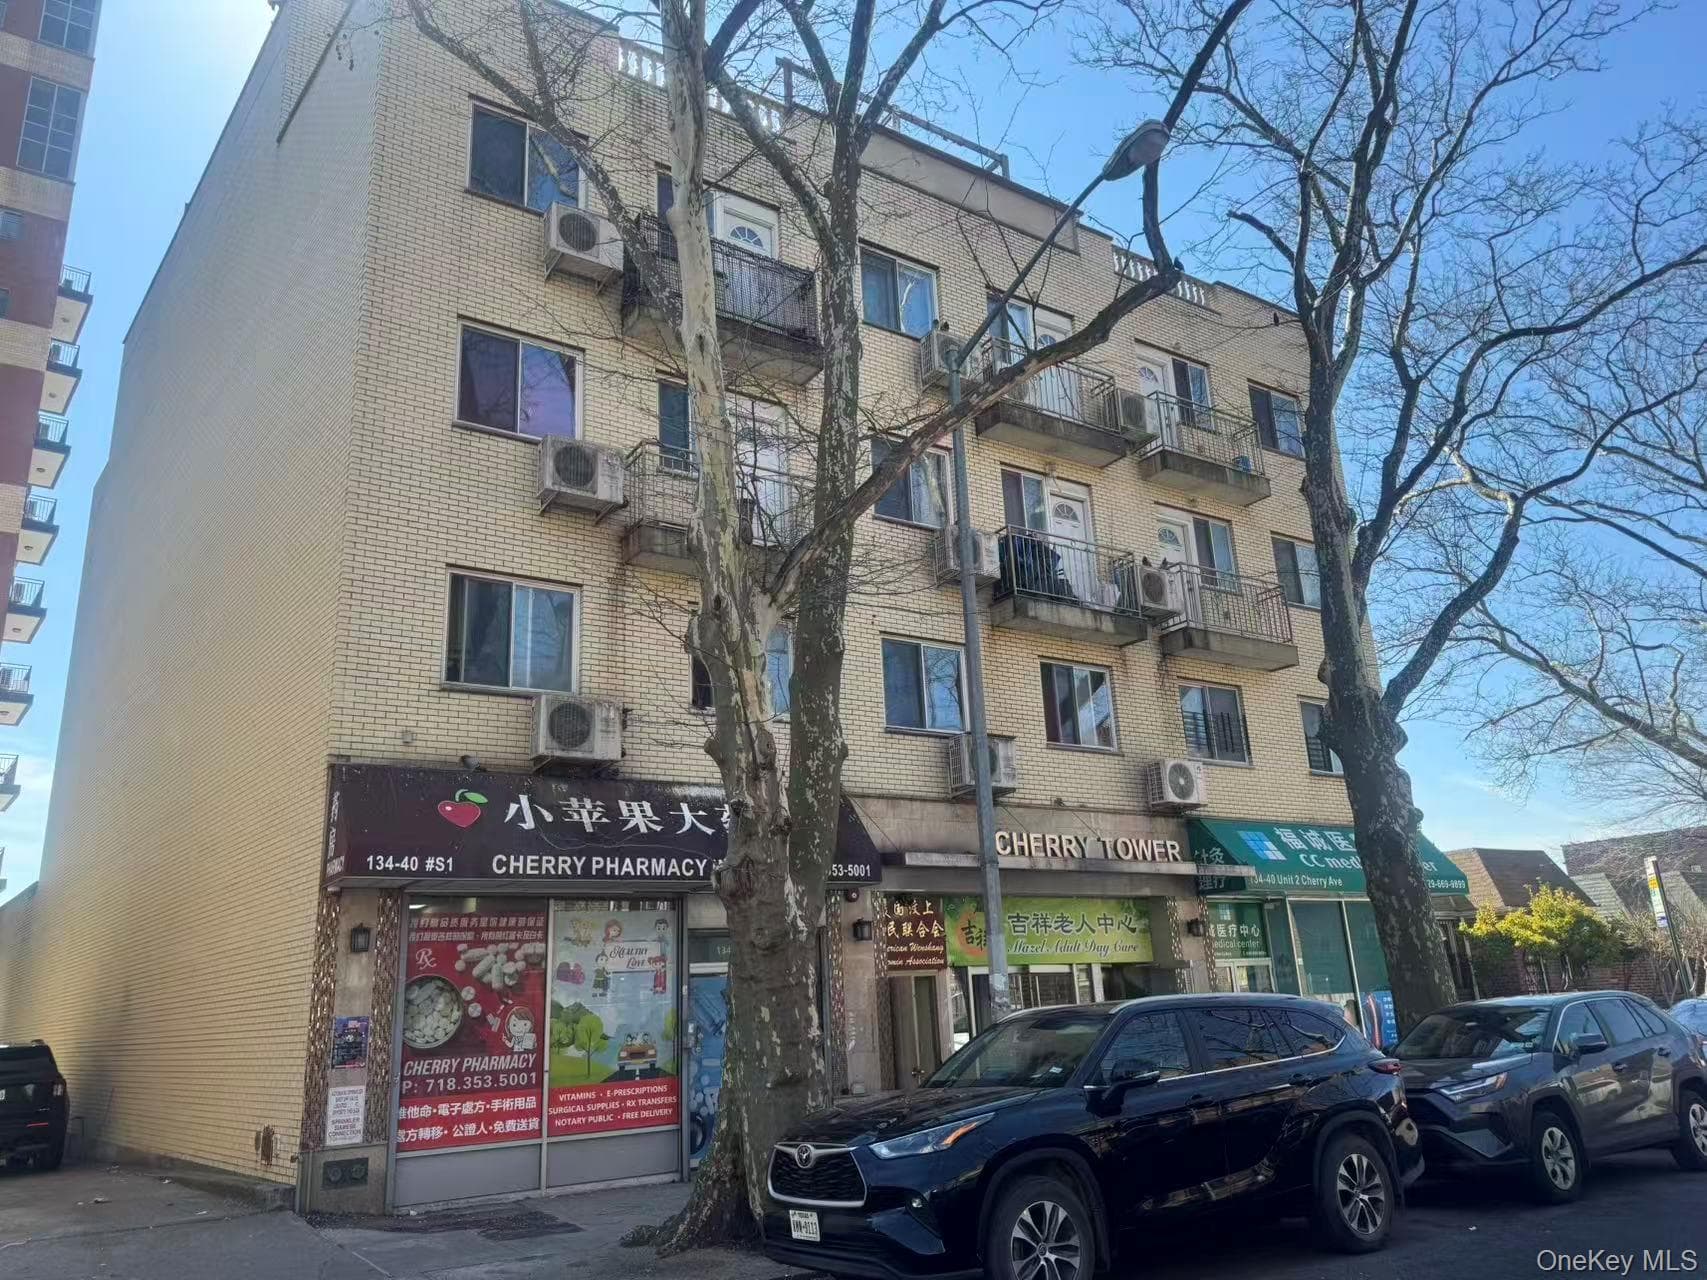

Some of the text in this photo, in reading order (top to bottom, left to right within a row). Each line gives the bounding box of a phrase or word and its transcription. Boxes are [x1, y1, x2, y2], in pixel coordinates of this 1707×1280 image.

[994, 831, 1181, 862] CHERRY TOWER
[1274, 828, 1357, 852] 福诚医
[367, 854, 453, 872] 134-40 #S1
[492, 854, 587, 875] CHERRY
[591, 856, 707, 877] PHARMACY
[1299, 853, 1325, 868] CC
[1276, 873, 1294, 885] Unit
[1295, 875, 1300, 885] 2
[1301, 875, 1327, 888] Cherry
[1328, 876, 1343, 887] Ave
[1007, 912, 1137, 935] 吉祥老人中心
[403, 1053, 537, 1077] CHERRY PHARMACY
[426, 1071, 537, 1093] 718.353.5001
[559, 1084, 668, 1102] VITAMINS E-PRESCRIPTIONS
[548, 1095, 677, 1115] SURGICAL SUPPLIES RX TRANSFERS
[555, 1107, 673, 1127] NOTARY PUBLIC FREE DELIVERY
